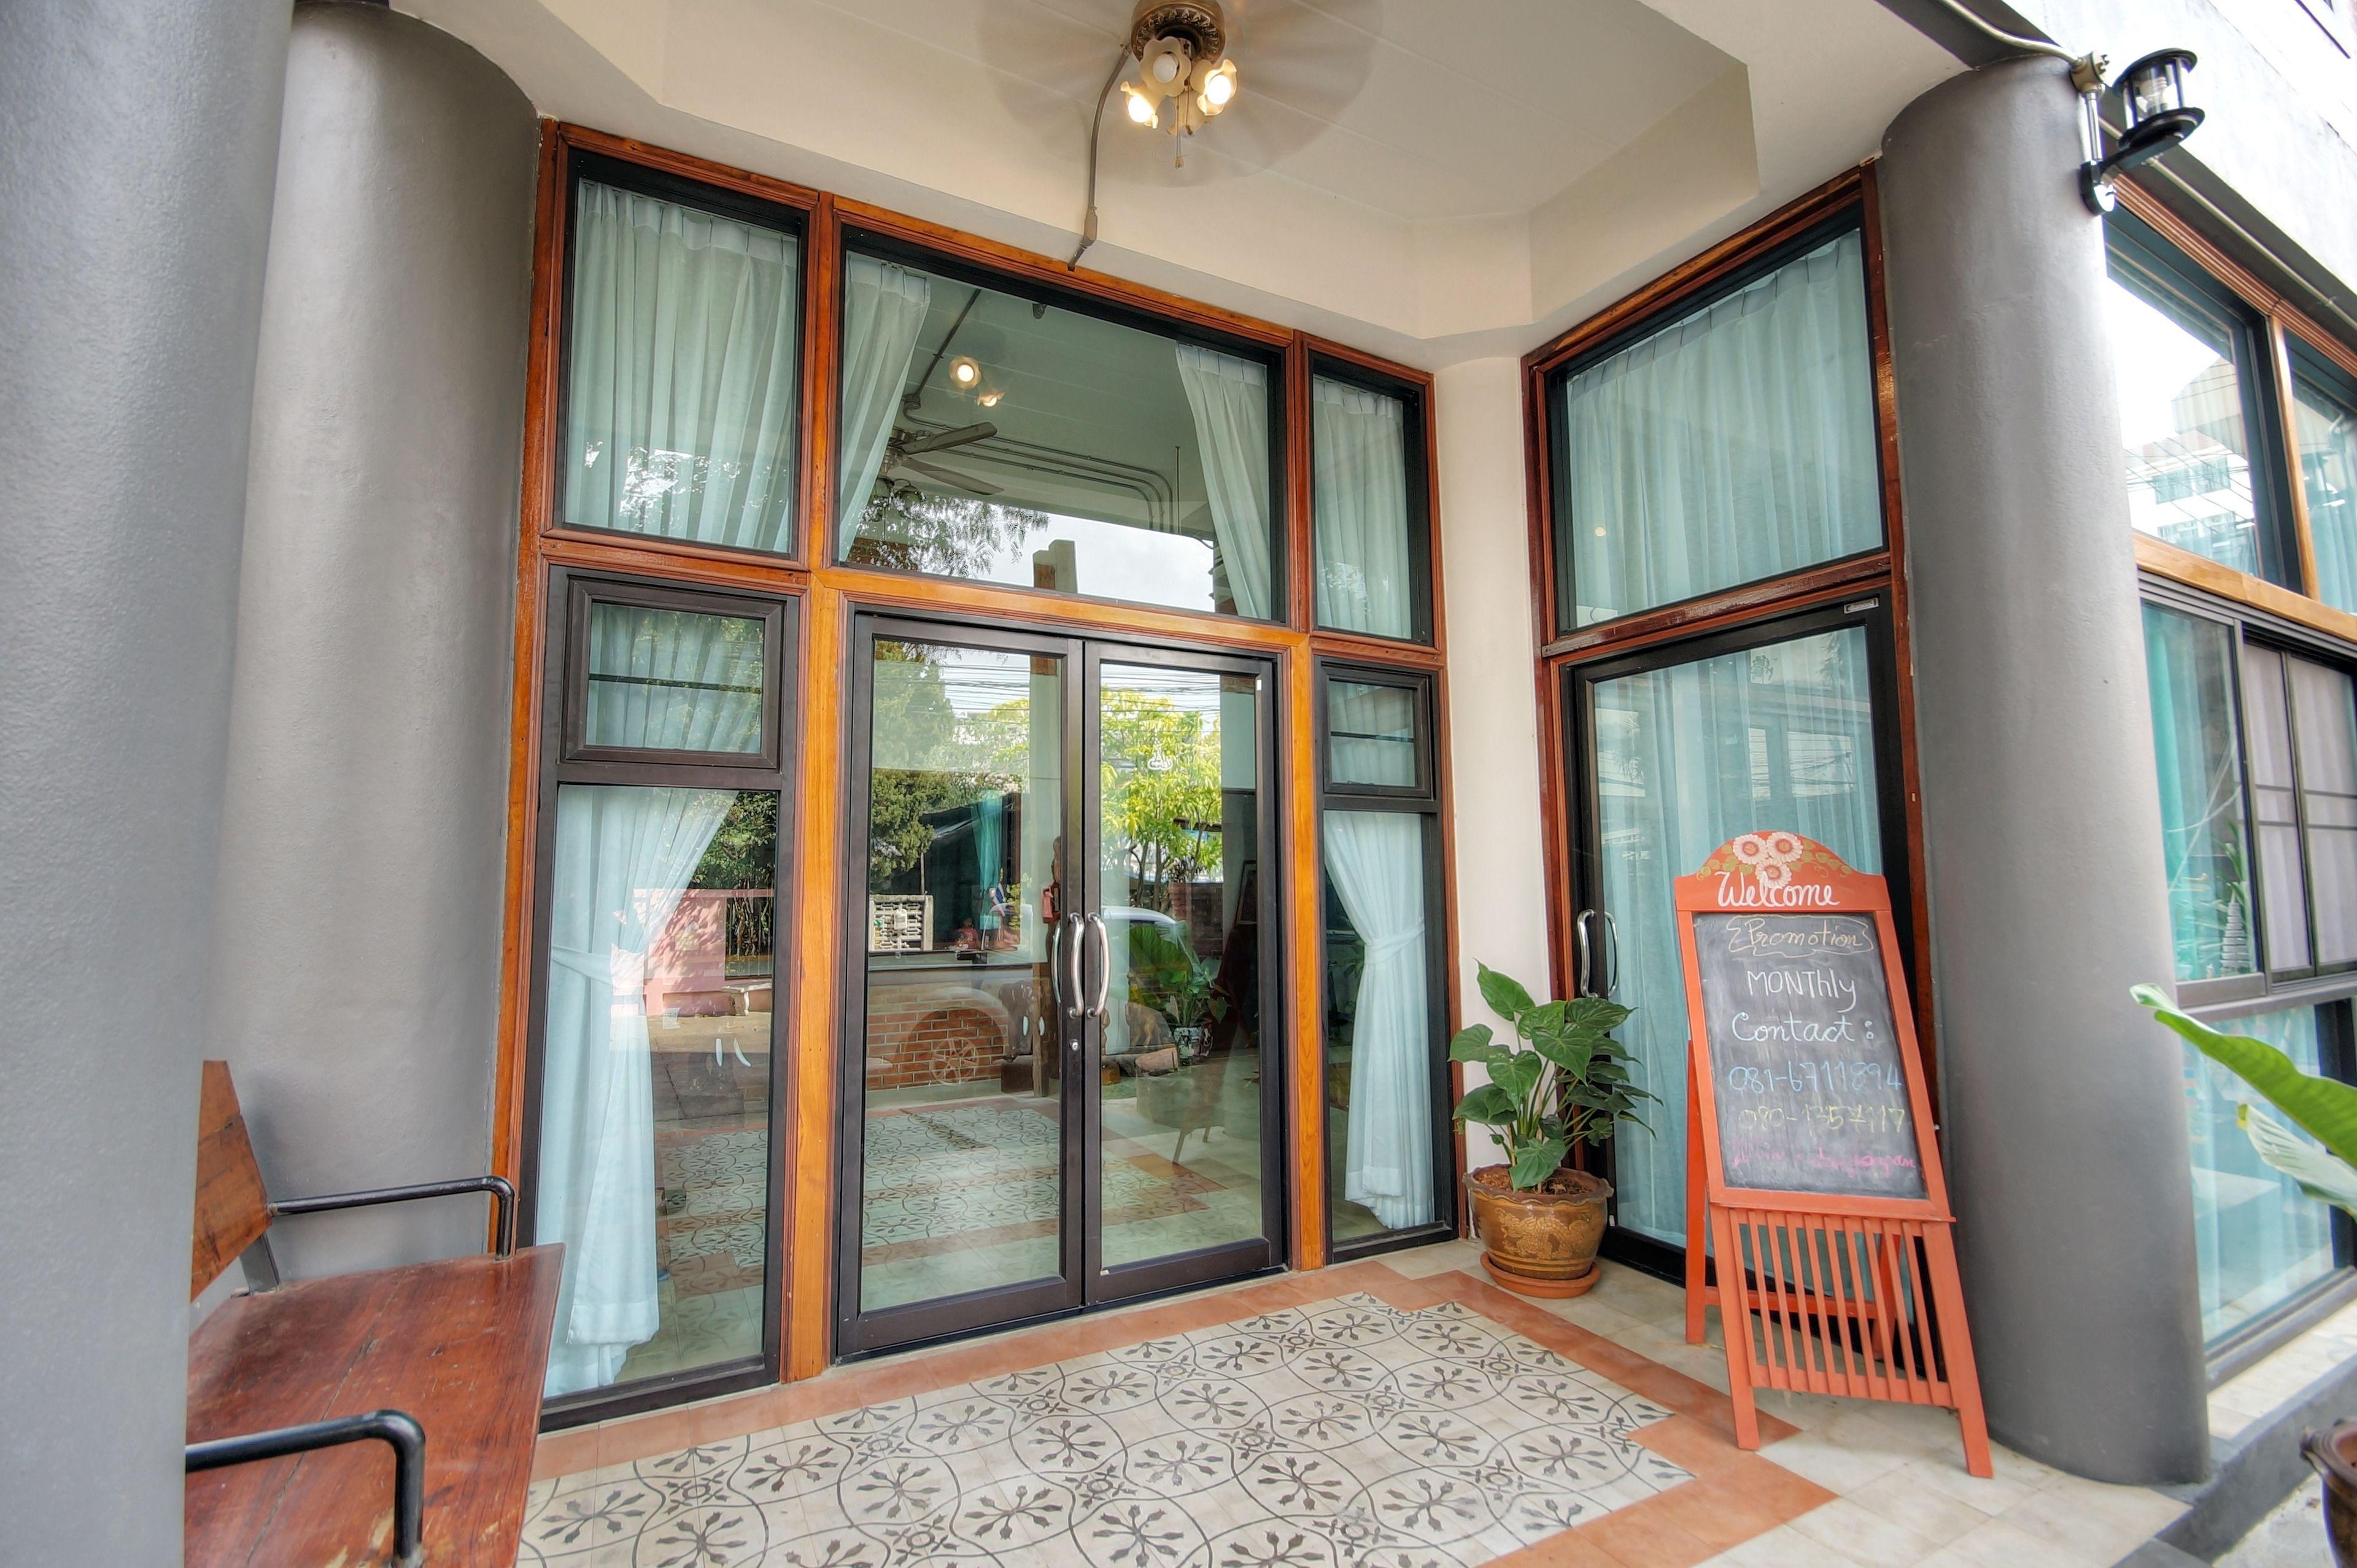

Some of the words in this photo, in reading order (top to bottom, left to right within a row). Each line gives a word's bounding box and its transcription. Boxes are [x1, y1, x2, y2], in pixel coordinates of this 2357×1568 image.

[1714, 871, 1840, 908] Welcome
[1744, 917, 1863, 947] Promotion
[1728, 1057, 1902, 1094] 081-6711894
